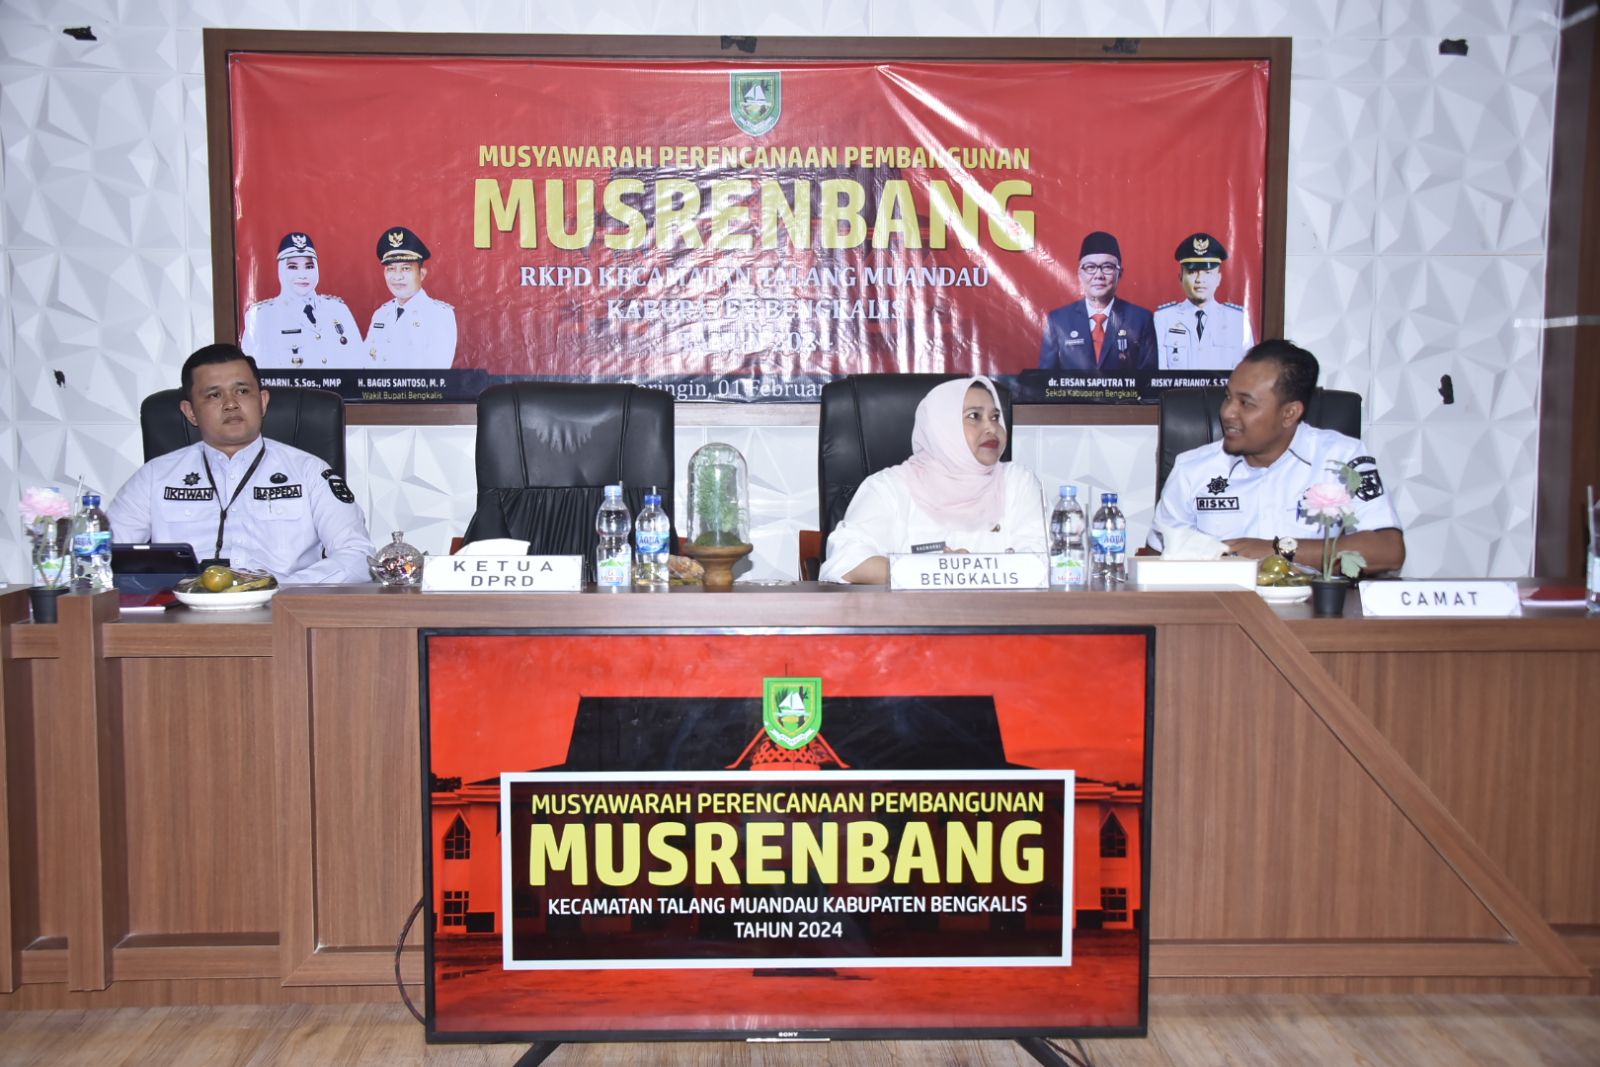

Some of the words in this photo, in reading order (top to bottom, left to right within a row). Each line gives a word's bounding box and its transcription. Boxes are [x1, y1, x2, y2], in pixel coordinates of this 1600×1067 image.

[479, 145, 652, 168] MUSYAWARAH
[659, 145, 837, 169] PERENCANAAN
[844, 146, 1030, 170] PEMBANGUNAN
[473, 178, 1035, 251] MUSRENBANG
[520, 266, 592, 287] RKPD
[598, 266, 751, 287] KECAMATAN
[760, 266, 857, 287] TALANG
[863, 266, 990, 288] MUANDAU
[322, 378, 342, 388] MMP
[366, 378, 392, 388] BAGUS
[717, 379, 742, 397] 01
[1048, 377, 1059, 387] dr.
[1060, 378, 1085, 387] ERSAN
[1086, 378, 1122, 388] SAPUTRA
[1124, 378, 1136, 388] TH
[1151, 378, 1172, 388] RISKY
[383, 391, 406, 402] Bupati
[1045, 389, 1066, 398] Sekda
[1067, 389, 1103, 400] Kabupaten
[1105, 390, 1138, 400] Bengkalis
[167, 487, 212, 499] IKHWAN
[1198, 499, 1236, 508] RISKY
[453, 560, 553, 572] KETUA
[938, 557, 999, 570] BUPATI
[470, 575, 534, 587] DPRD
[920, 572, 1019, 586] BENGKALIS
[1400, 591, 1478, 606] CAMAT
[531, 793, 692, 815] MUSYAWARAH
[697, 792, 865, 814] PERENCANAAN
[870, 791, 1044, 813] PEMBANGUNAN
[529, 820, 1045, 887] MUSRENBANG
[548, 898, 652, 915] KECAMATAN
[657, 897, 725, 914] TALANG
[730, 897, 819, 914] MUANDAU
[823, 896, 926, 913] KABUPATEN
[930, 896, 1028, 913] BENGKALIS
[734, 921, 793, 938] TAHUN
[798, 921, 843, 938] 2024
